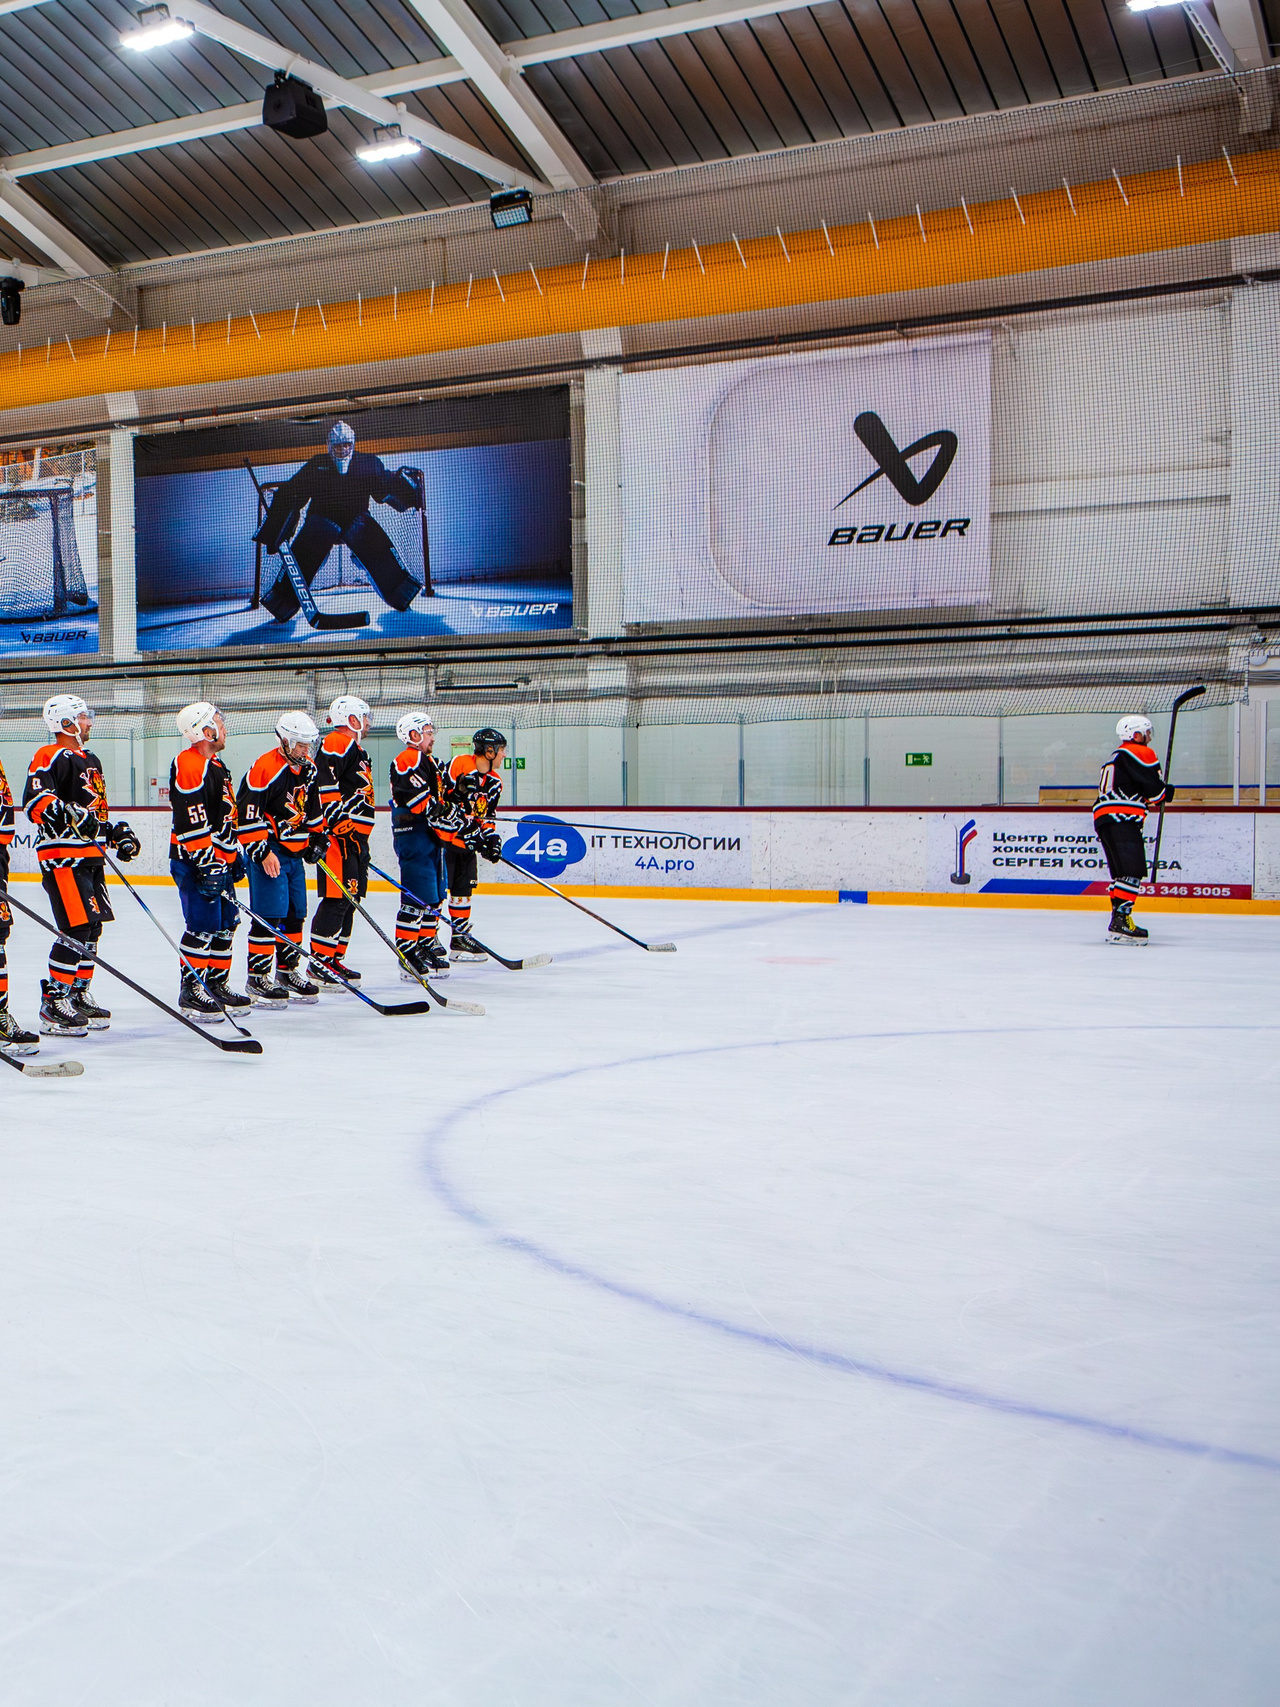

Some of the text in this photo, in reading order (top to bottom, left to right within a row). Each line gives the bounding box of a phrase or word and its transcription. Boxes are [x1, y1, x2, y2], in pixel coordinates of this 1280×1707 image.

[827, 518, 971, 546] BAUER
[284, 554, 315, 613] BAUER
[486, 603, 558, 617] BAUER
[33, 630, 88, 642] BAUER
[187, 803, 207, 824] 55
[591, 835, 741, 850] IT ТЕХНОЛОГИИ
[992, 832, 1048, 843] Центр
[992, 845, 1099, 854] хоккеистов
[635, 856, 695, 873] 4A.pro
[992, 857, 1064, 868] СЕРГЕЯ
[1160, 886, 1188, 896] 346
[1192, 887, 1231, 897] 3005
